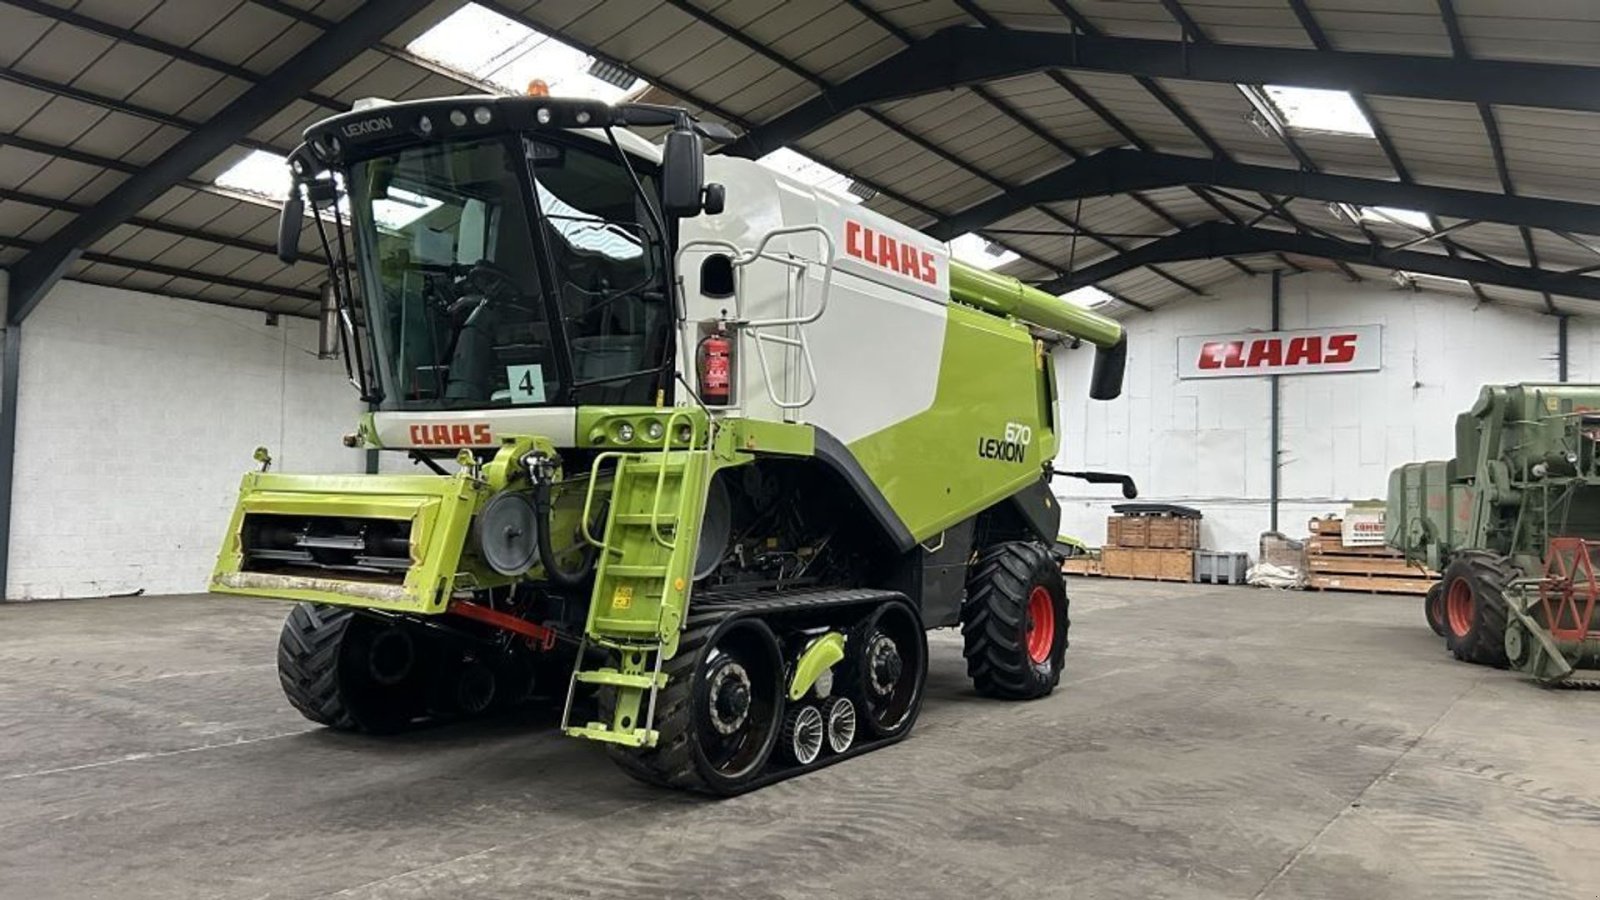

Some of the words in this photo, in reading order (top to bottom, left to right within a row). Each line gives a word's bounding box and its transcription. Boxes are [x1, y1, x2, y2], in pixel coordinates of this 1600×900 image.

[341, 116, 393, 137] LEXION
[846, 220, 937, 285] CLAAS
[1198, 334, 1358, 369] CLAAS
[518, 369, 535, 396] 4
[409, 424, 492, 445] CLAAS
[1005, 422, 1031, 445] 670
[978, 437, 1025, 463] LEXION
